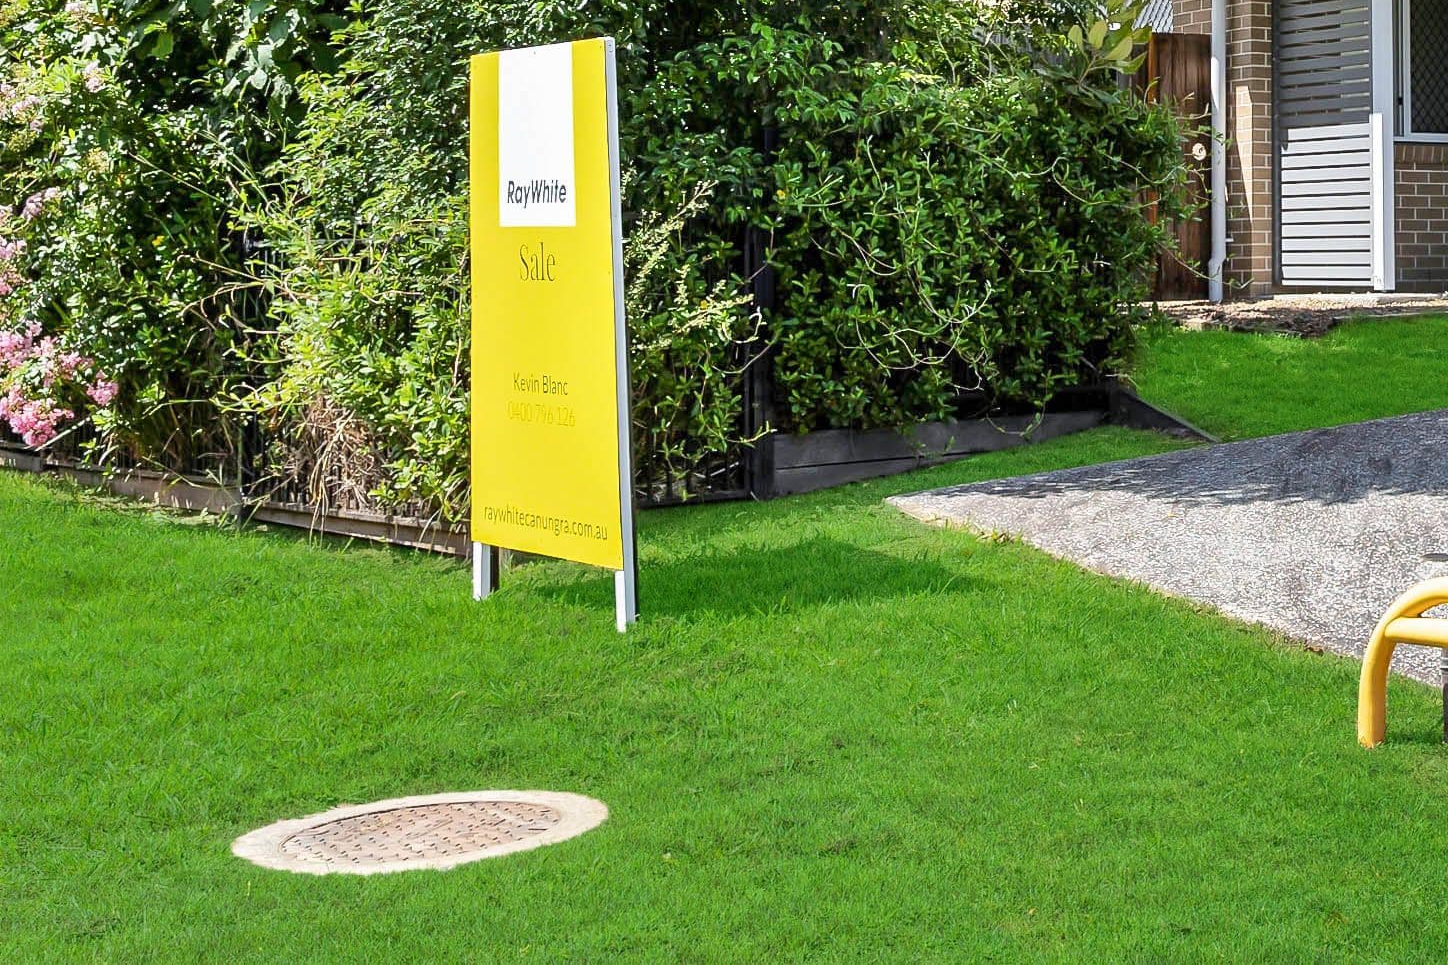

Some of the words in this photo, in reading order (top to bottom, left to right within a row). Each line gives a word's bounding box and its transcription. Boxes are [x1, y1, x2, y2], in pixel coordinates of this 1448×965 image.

[519, 241, 556, 282] Sale
[513, 372, 540, 394] Kevin
[542, 374, 569, 396] Blanc
[507, 400, 532, 423] 0400
[483, 504, 608, 540] raywhitecanungra.com.au
